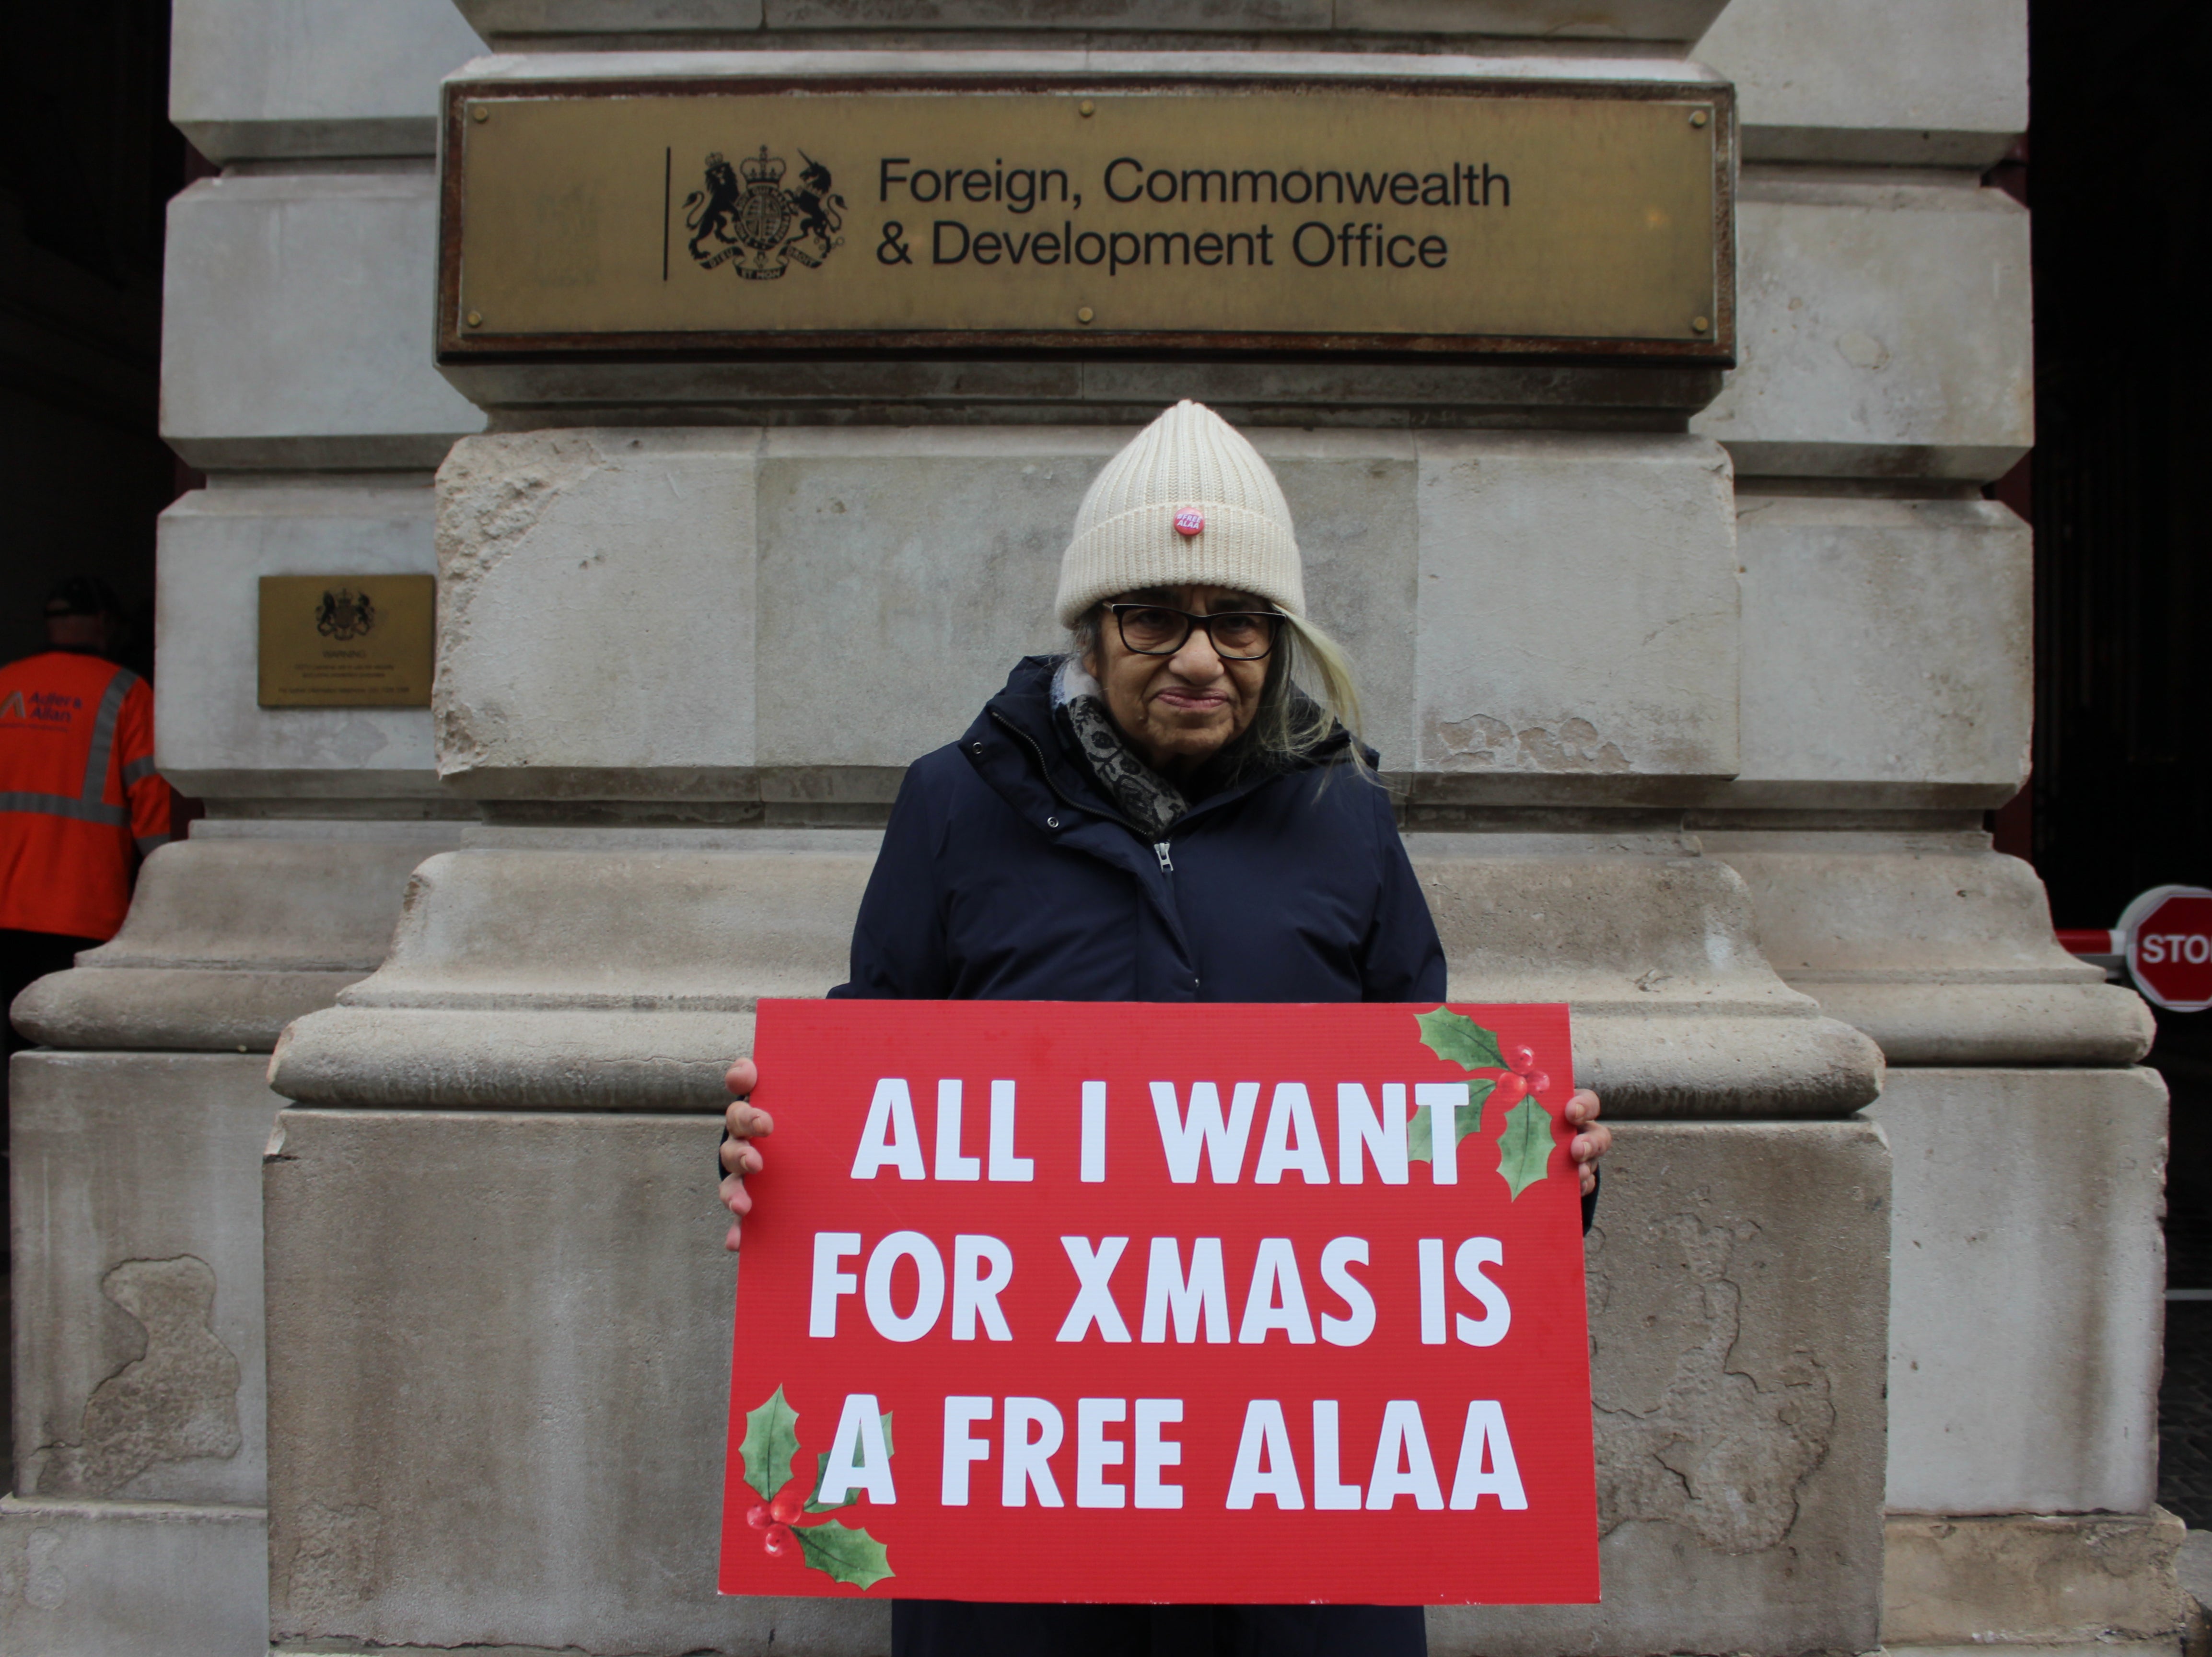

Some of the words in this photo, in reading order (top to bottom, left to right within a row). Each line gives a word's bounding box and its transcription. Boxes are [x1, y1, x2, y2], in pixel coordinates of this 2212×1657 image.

[880, 159, 1081, 213] Foreign,
[1104, 158, 1509, 206] Commonwealth
[877, 221, 912, 265] &
[933, 221, 1273, 276] Development
[1293, 222, 1447, 268] Office
[1176, 514, 1202, 523] #FREE
[1177, 520, 1199, 529] ALAA
[31, 707, 71, 721] Allan
[2142, 934, 2212, 964] STO
[850, 1078, 1034, 1182] ALL
[1081, 1081, 1106, 1182] I
[1149, 1082, 1469, 1185] WANT
[809, 1231, 1013, 1342] FOR
[1056, 1236, 1376, 1347] XMAS
[1419, 1237, 1511, 1347] IS
[817, 1394, 896, 1505] A
[942, 1396, 1183, 1509] FREE
[1225, 1400, 1528, 1510] ALAA
